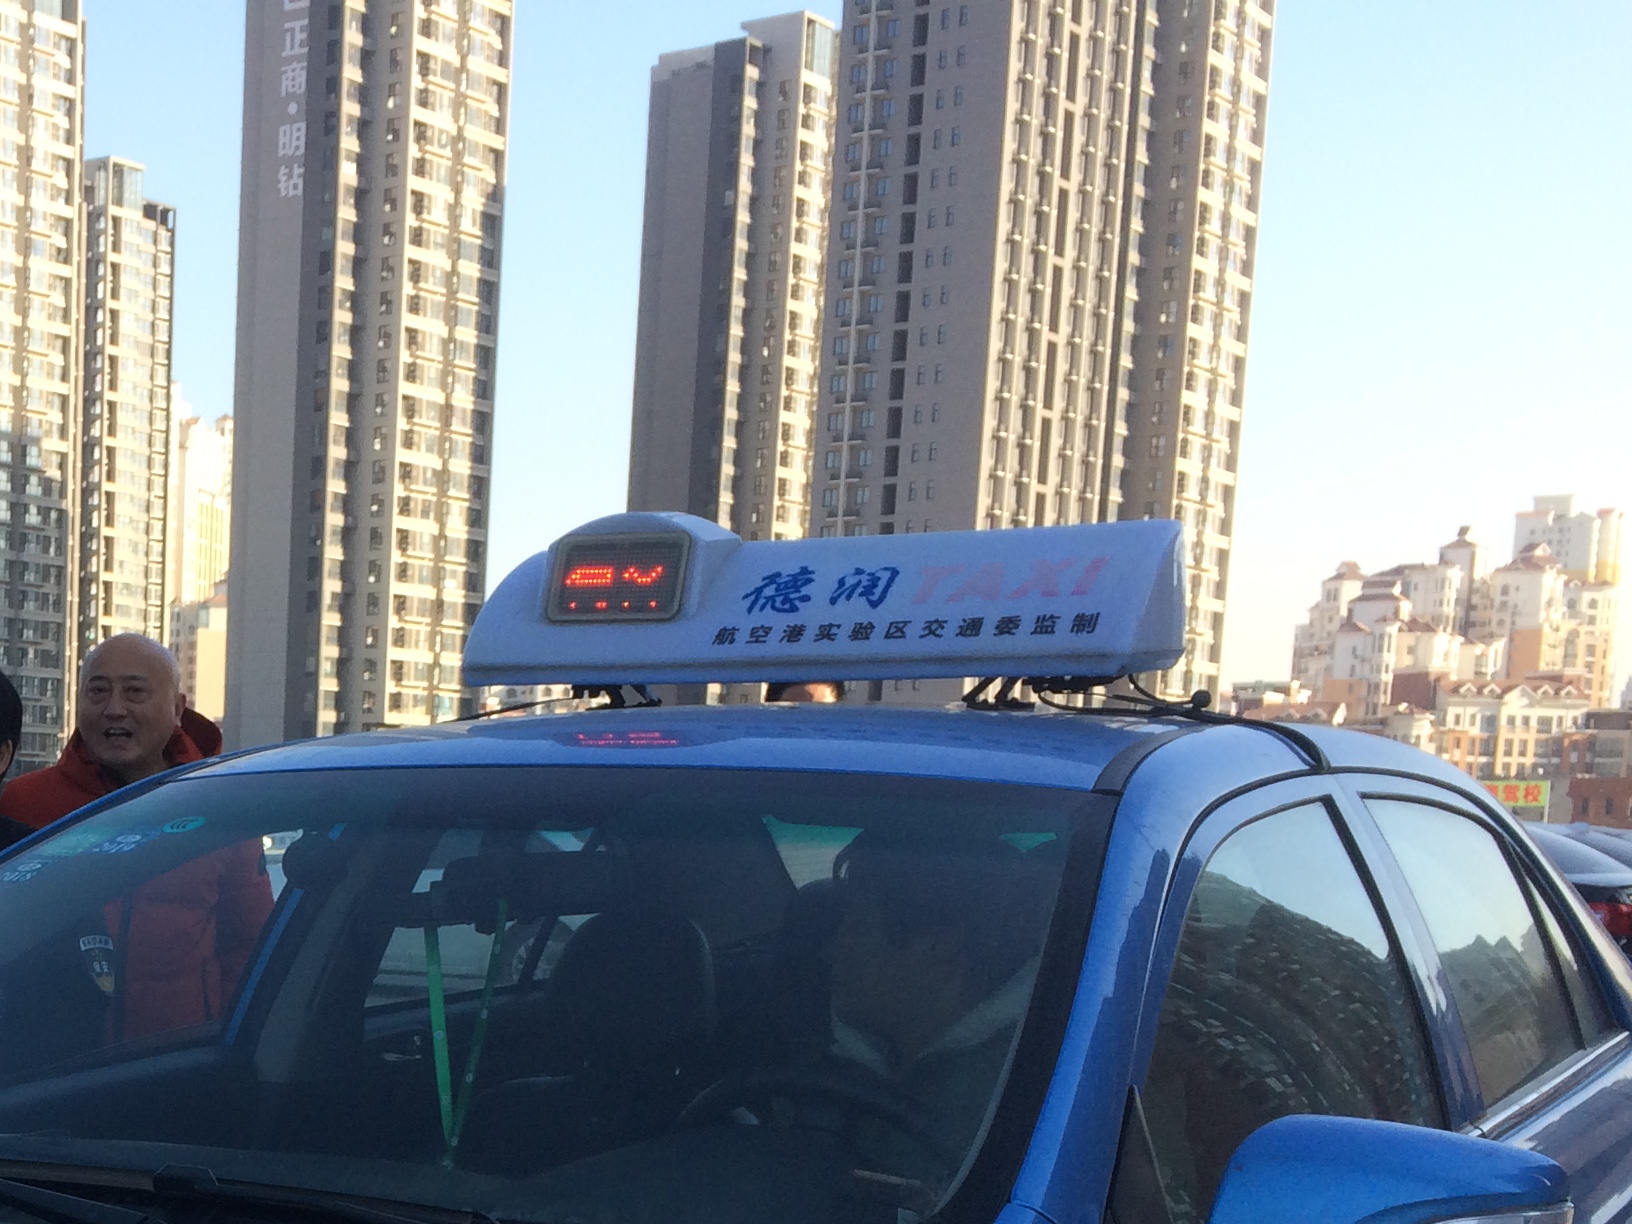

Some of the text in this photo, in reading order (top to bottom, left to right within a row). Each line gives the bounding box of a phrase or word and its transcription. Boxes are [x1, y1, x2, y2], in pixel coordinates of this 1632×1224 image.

[742, 554, 1113, 616] 德润 TAXI
[712, 611, 1102, 648] 航空港实验区交通委监制
